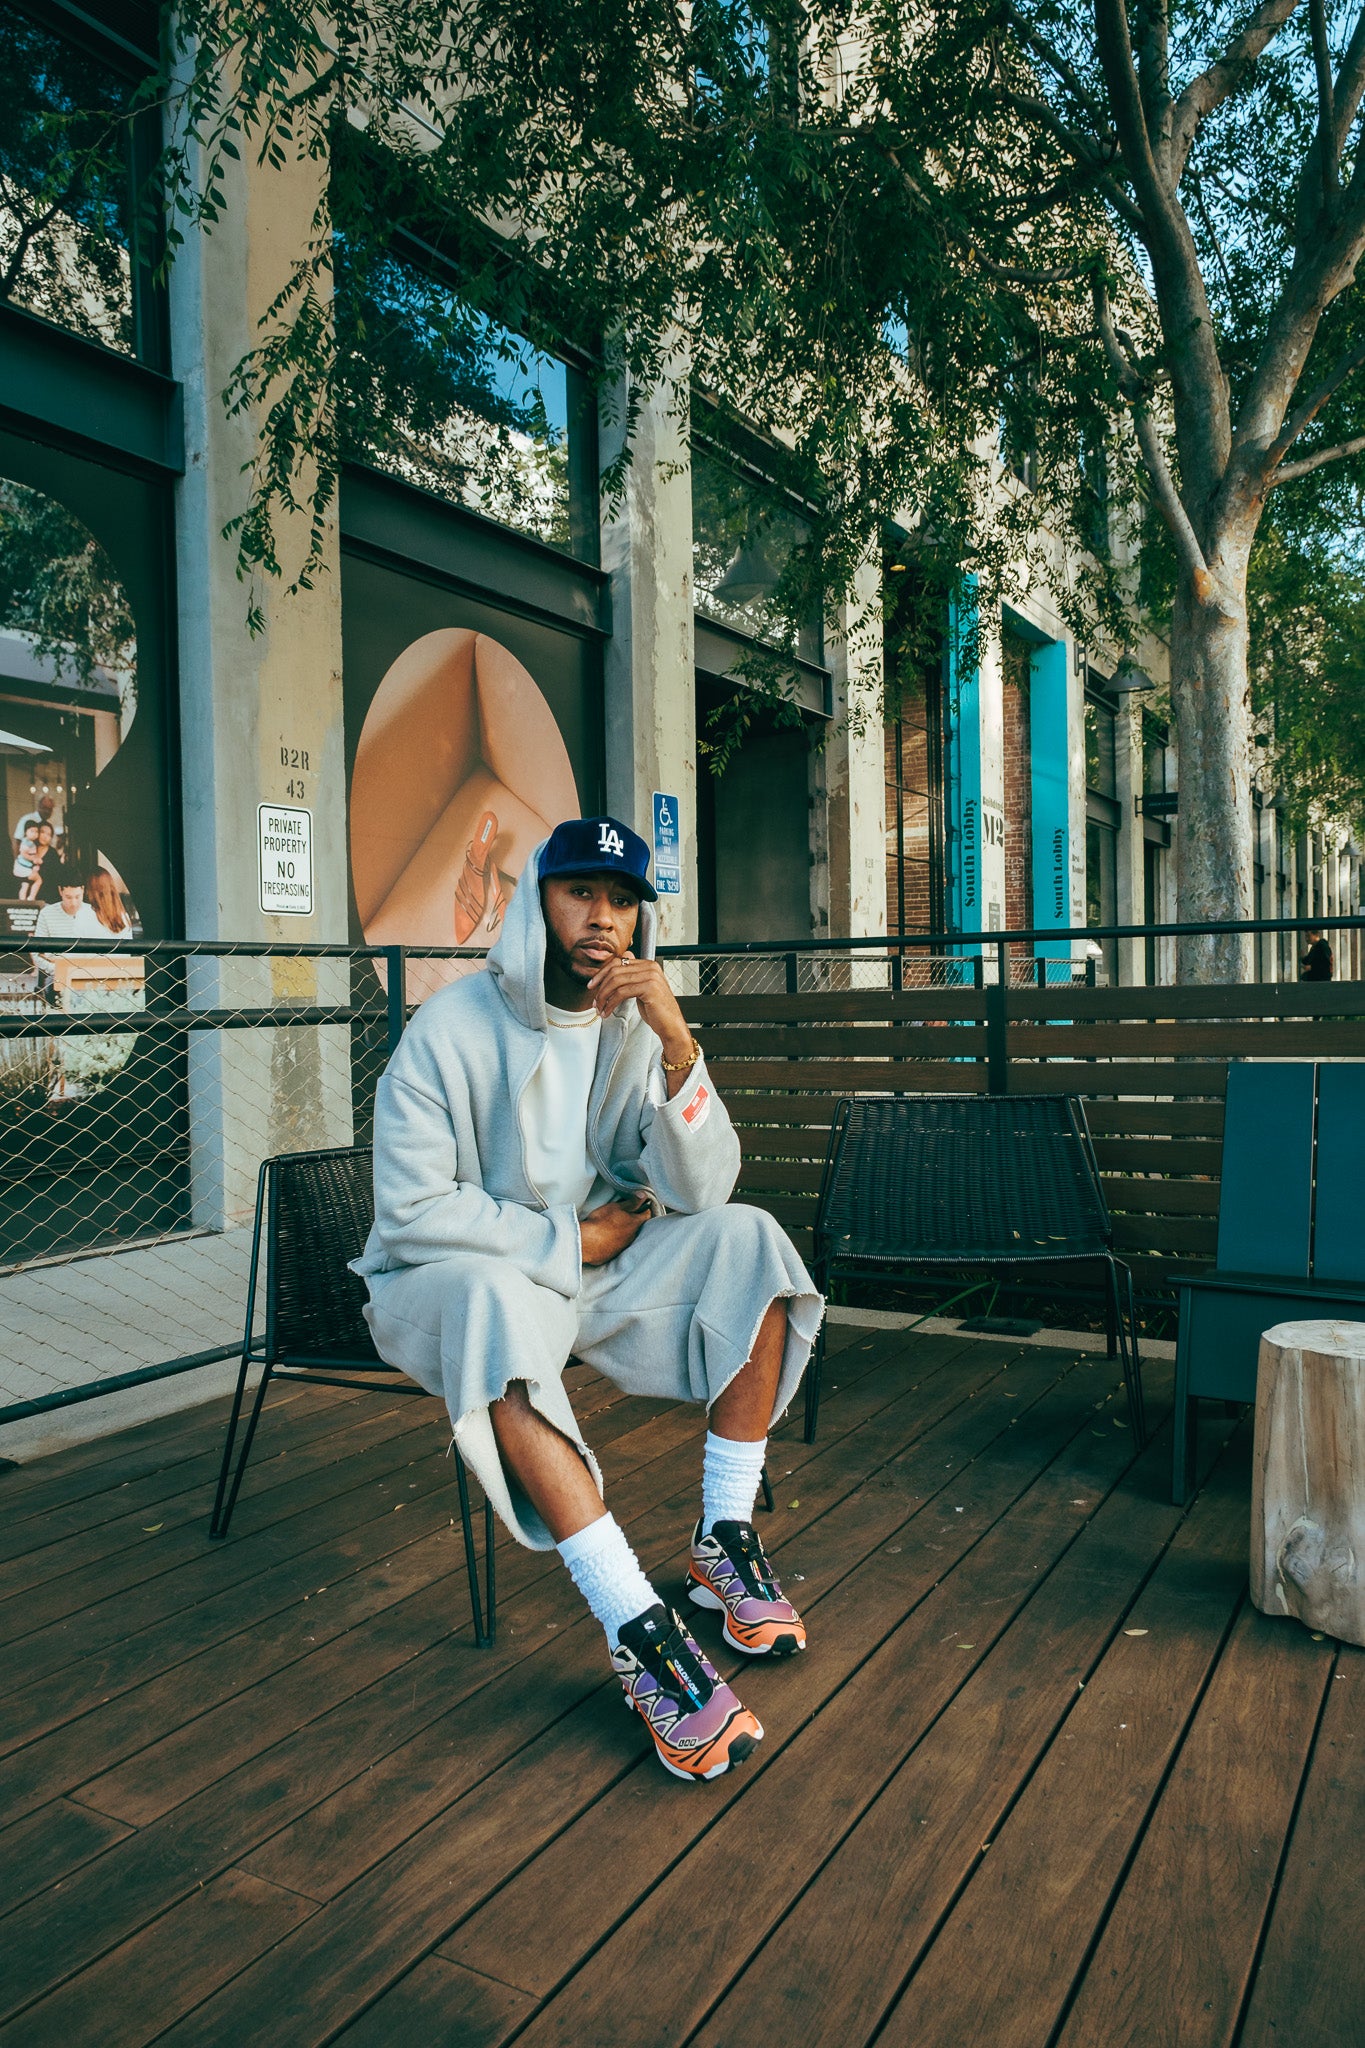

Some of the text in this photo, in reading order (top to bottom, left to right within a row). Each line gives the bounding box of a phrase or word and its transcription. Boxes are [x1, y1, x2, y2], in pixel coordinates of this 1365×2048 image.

[280, 747, 309, 771] B2R
[286, 779, 305, 799] 43
[269, 818, 302, 835] PRIVATE
[983, 813, 1003, 847] M2
[264, 836, 307, 854] PROPERTY
[598, 823, 624, 857] LA
[964, 798, 977, 907] South Lobby
[277, 860, 296, 879] NO
[1053, 826, 1065, 918] South Lobby
[264, 881, 309, 897] TRESPASSING
